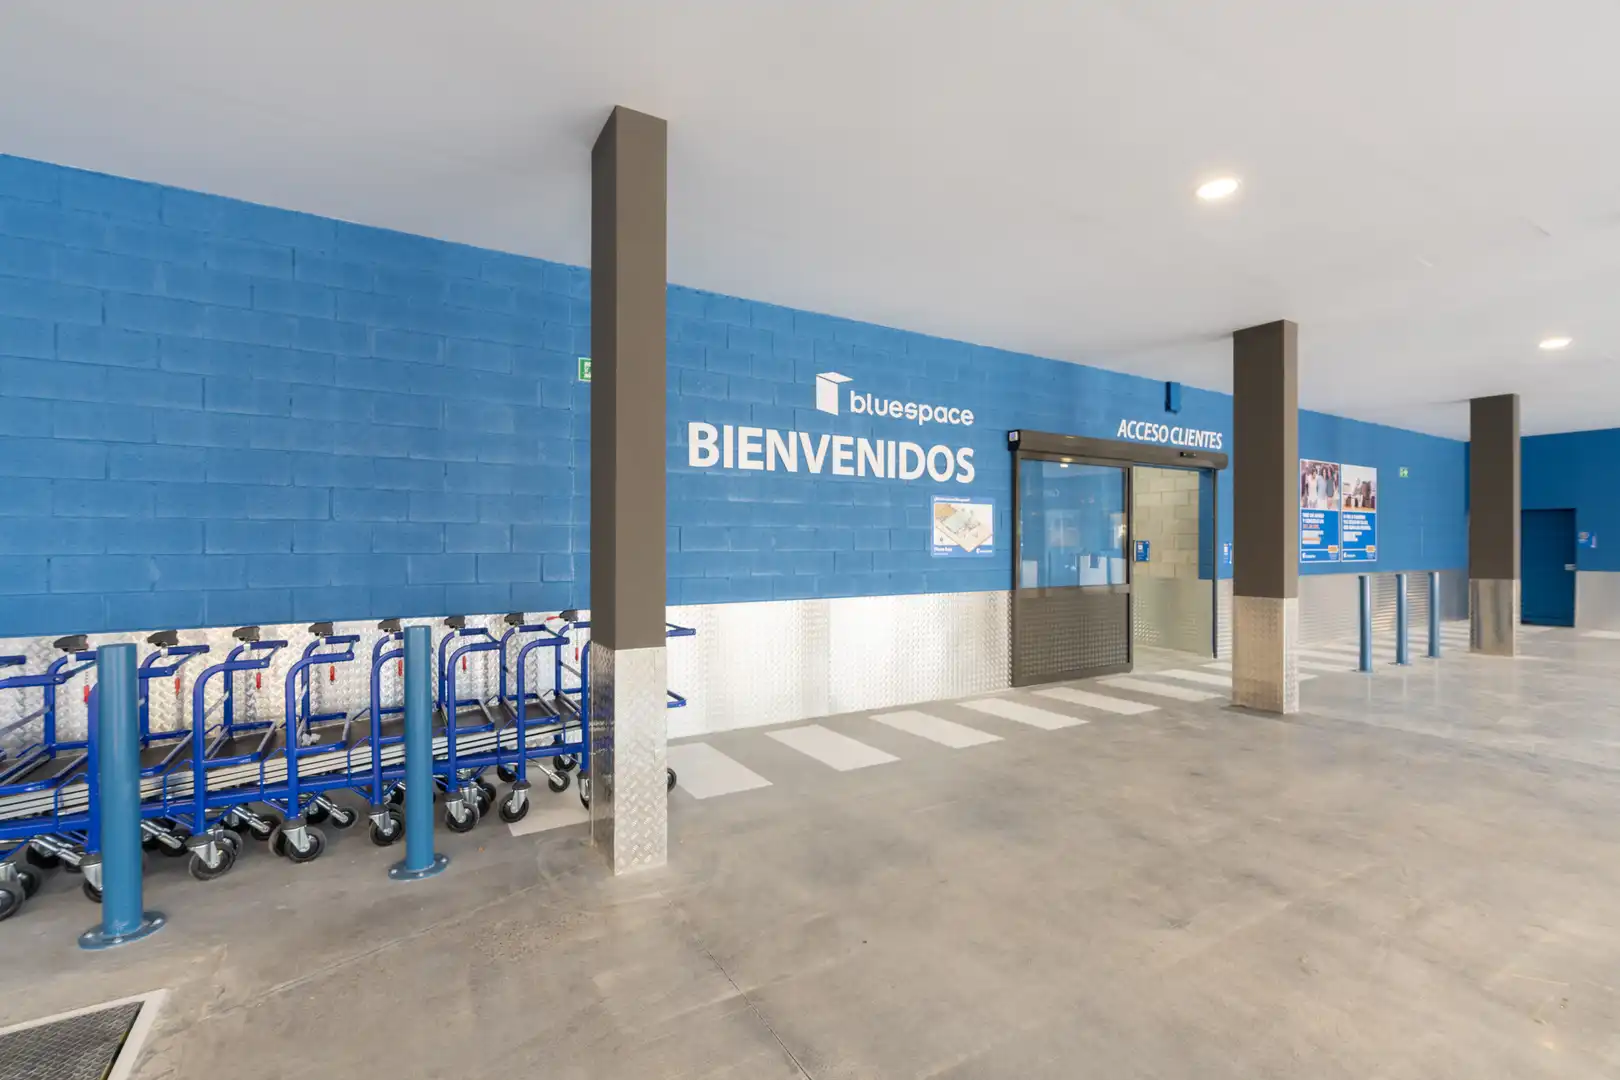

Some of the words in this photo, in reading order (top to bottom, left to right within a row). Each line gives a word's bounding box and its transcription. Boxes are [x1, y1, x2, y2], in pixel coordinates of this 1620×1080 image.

[850, 390, 974, 426] bluespace
[688, 421, 975, 484] BIENVENIDOS
[1117, 419, 1169, 443] ACCESO
[1170, 426, 1223, 450] CLIENTES
